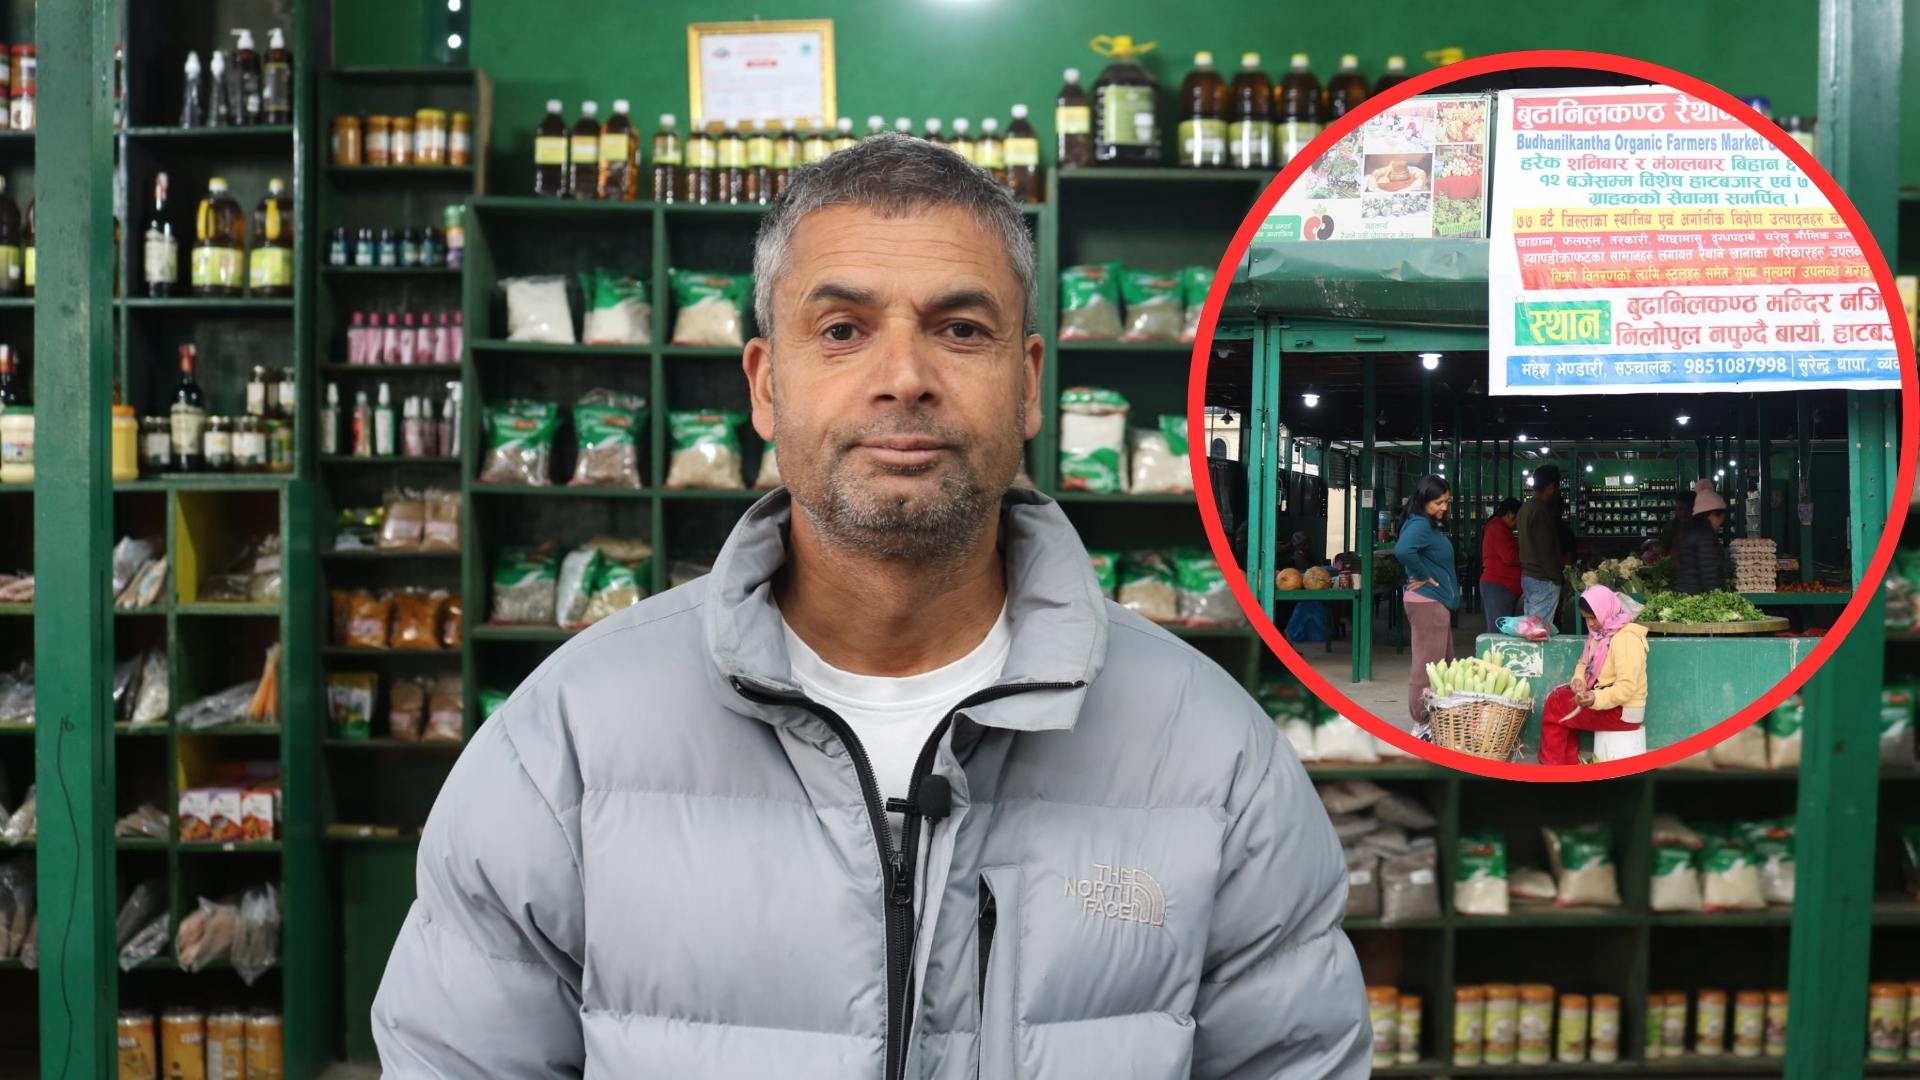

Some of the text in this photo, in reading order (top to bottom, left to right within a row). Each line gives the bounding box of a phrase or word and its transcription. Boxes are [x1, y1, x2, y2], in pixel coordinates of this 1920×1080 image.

[1517, 98, 1666, 129] बुढानिलकण्ठ
[1517, 133, 1611, 151] Budhanilkantha
[1615, 133, 1662, 155] Organic
[1667, 132, 1717, 151] Farmers
[1721, 131, 1764, 151] Market
[1520, 153, 1561, 170] हरेक
[1567, 153, 1629, 171] शनिबार
[1635, 158, 1647, 170] र
[1652, 156, 1725, 171] मंगलबार
[1731, 154, 1779, 171] बिहान
[1540, 174, 1561, 187] १२
[1567, 172, 1633, 188] बजेसम्म
[1639, 171, 1683, 188] विशेष
[1689, 175, 1763, 188] हाटबजार
[1769, 174, 1792, 188] एवं
[1588, 189, 1661, 206] ग्राहकको
[1667, 189, 1719, 205] सेवामा
[1561, 209, 1608, 229] जिल्लाका
[1627, 290, 1759, 320] बुढानिलकण्ठ
[1766, 288, 1833, 314] मन्दिर
[1616, 321, 1702, 349] निलोपुल
[1521, 359, 1549, 379] महेश
[1556, 358, 1607, 378] भण्डारी,
[1684, 356, 1786, 375] 9851087998
[1797, 354, 1830, 377] सुरेन्द्र
[1837, 357, 1870, 374] थापा,
[1093, 863, 1132, 885] THE
[1064, 876, 1131, 904] NORTH
[1082, 897, 1133, 921] FACE
